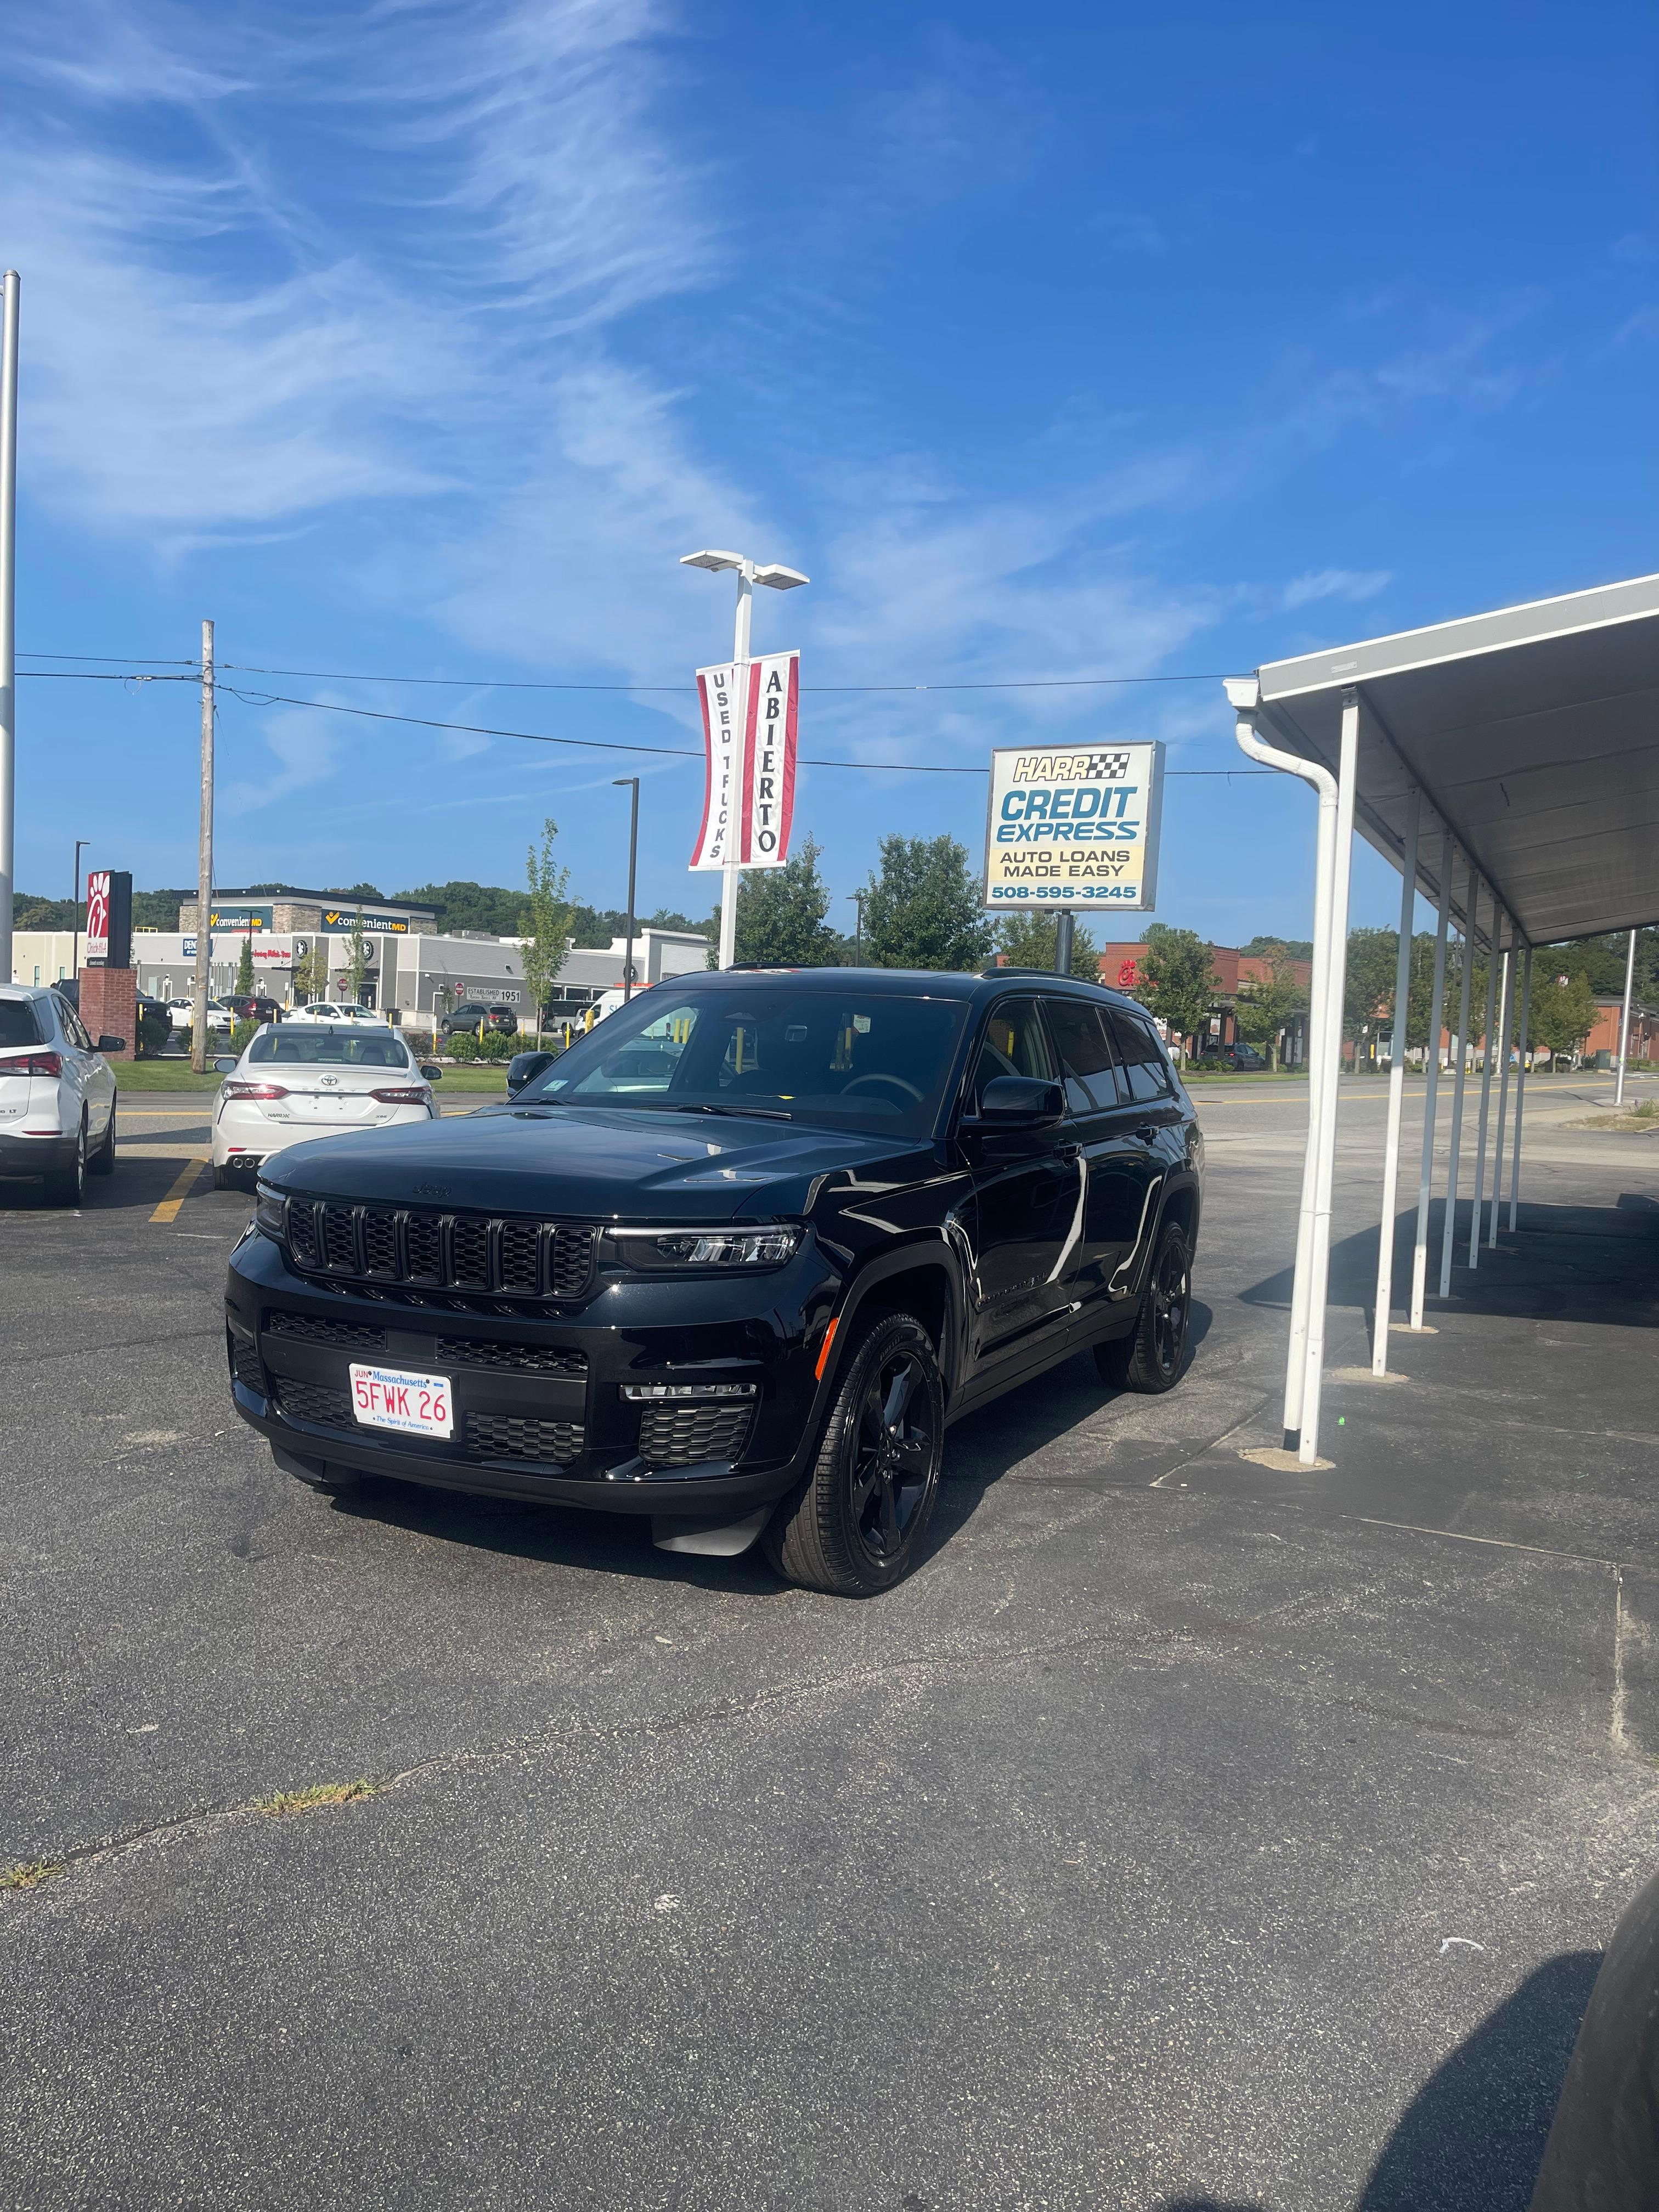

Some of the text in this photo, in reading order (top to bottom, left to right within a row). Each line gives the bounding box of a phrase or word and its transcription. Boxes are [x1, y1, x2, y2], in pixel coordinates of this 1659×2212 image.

[713, 673, 731, 744] USED
[758, 670, 783, 853] ABIERTO
[1013, 754, 1092, 783] HARR
[1001, 786, 1138, 821] CREDIT
[996, 821, 1140, 843] EXPRESS
[1000, 850, 1130, 863] AUTO LOANS
[1004, 865, 1125, 877] MADE EASY
[991, 886, 1137, 899] 508-595-3245
[216, 916, 262, 927] convenienMD
[501, 991, 520, 1002] 1951
[354, 1370, 427, 1389] JUN Massachusetts
[356, 1380, 446, 1421] 5FWK 26
[387, 1417, 400, 1425] Spirit
[407, 1421, 429, 1430] America
